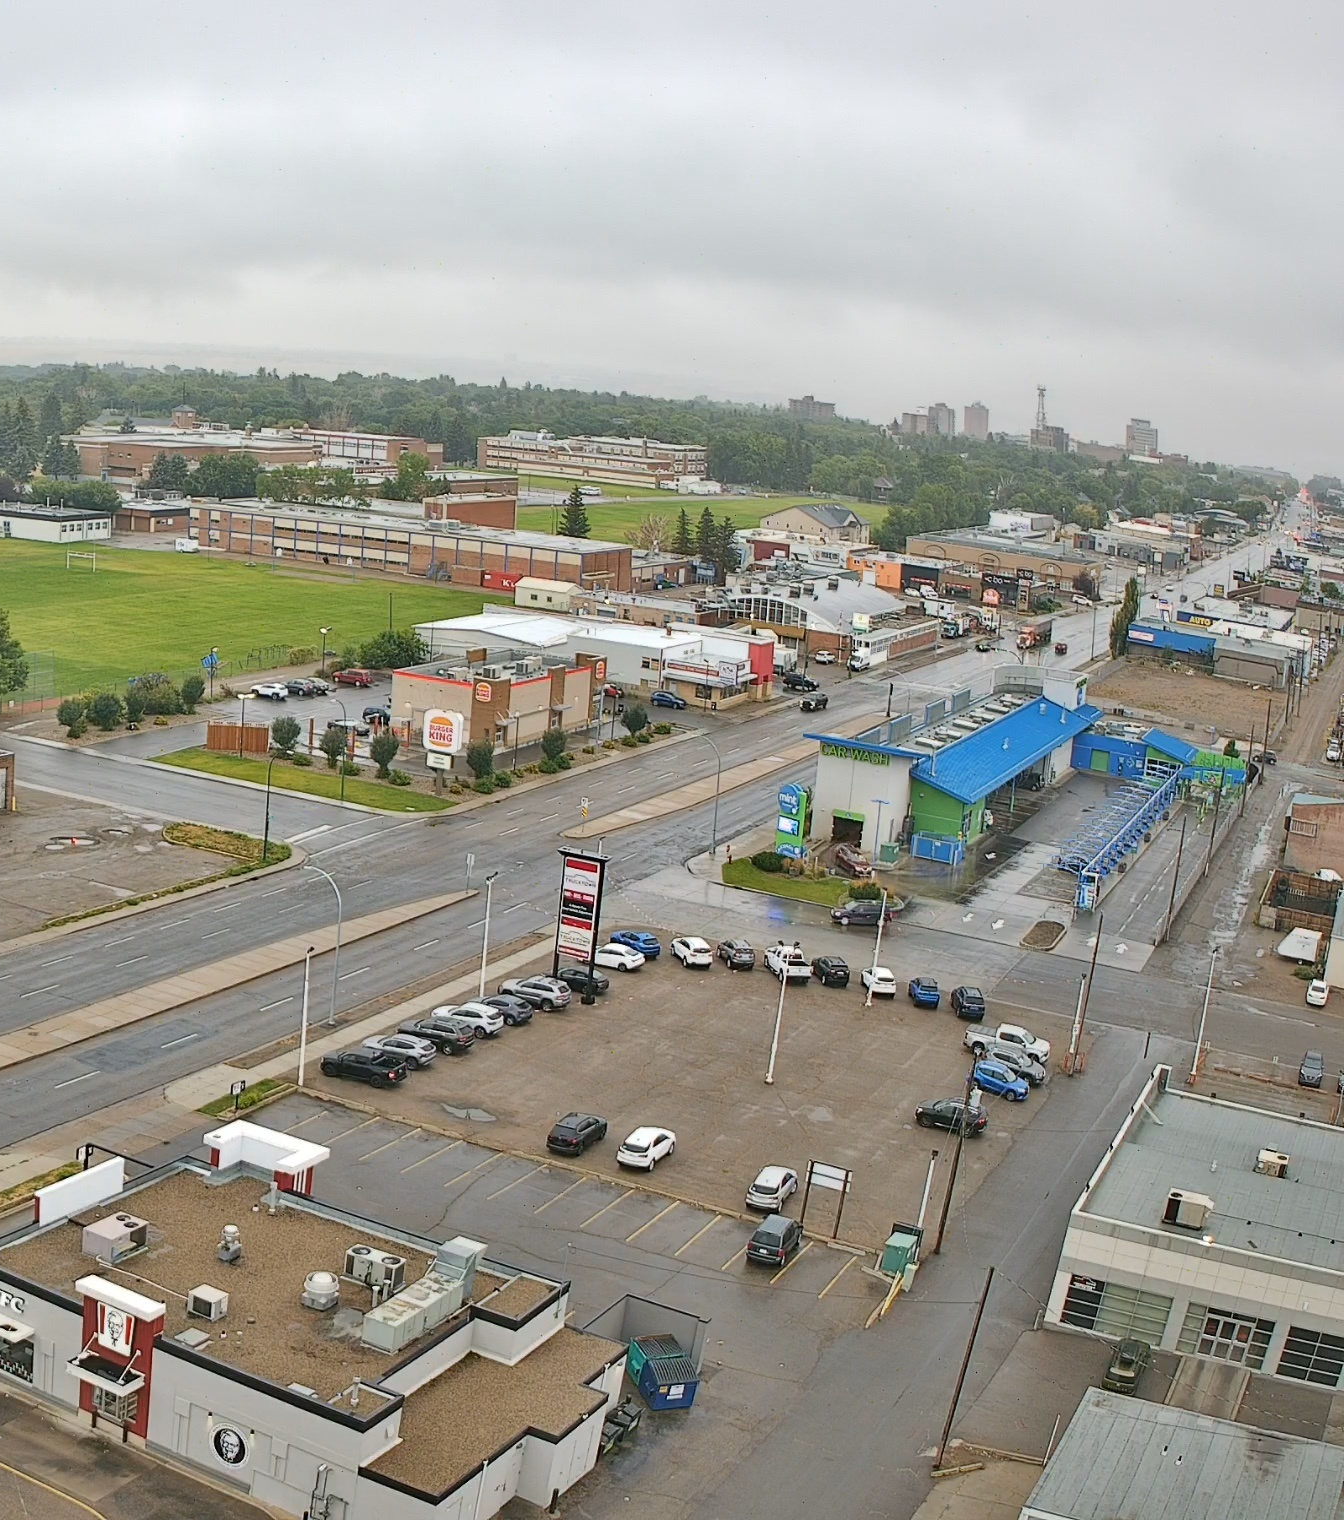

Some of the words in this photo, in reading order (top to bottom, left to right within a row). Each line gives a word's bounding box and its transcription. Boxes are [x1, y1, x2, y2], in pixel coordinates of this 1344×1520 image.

[1189, 616, 1211, 626] AUTO
[429, 724, 454, 734] BURGER
[429, 731, 453, 742] KING
[820, 744, 847, 759] CAR
[850, 748, 891, 766] WASH
[779, 793, 798, 805] mint
